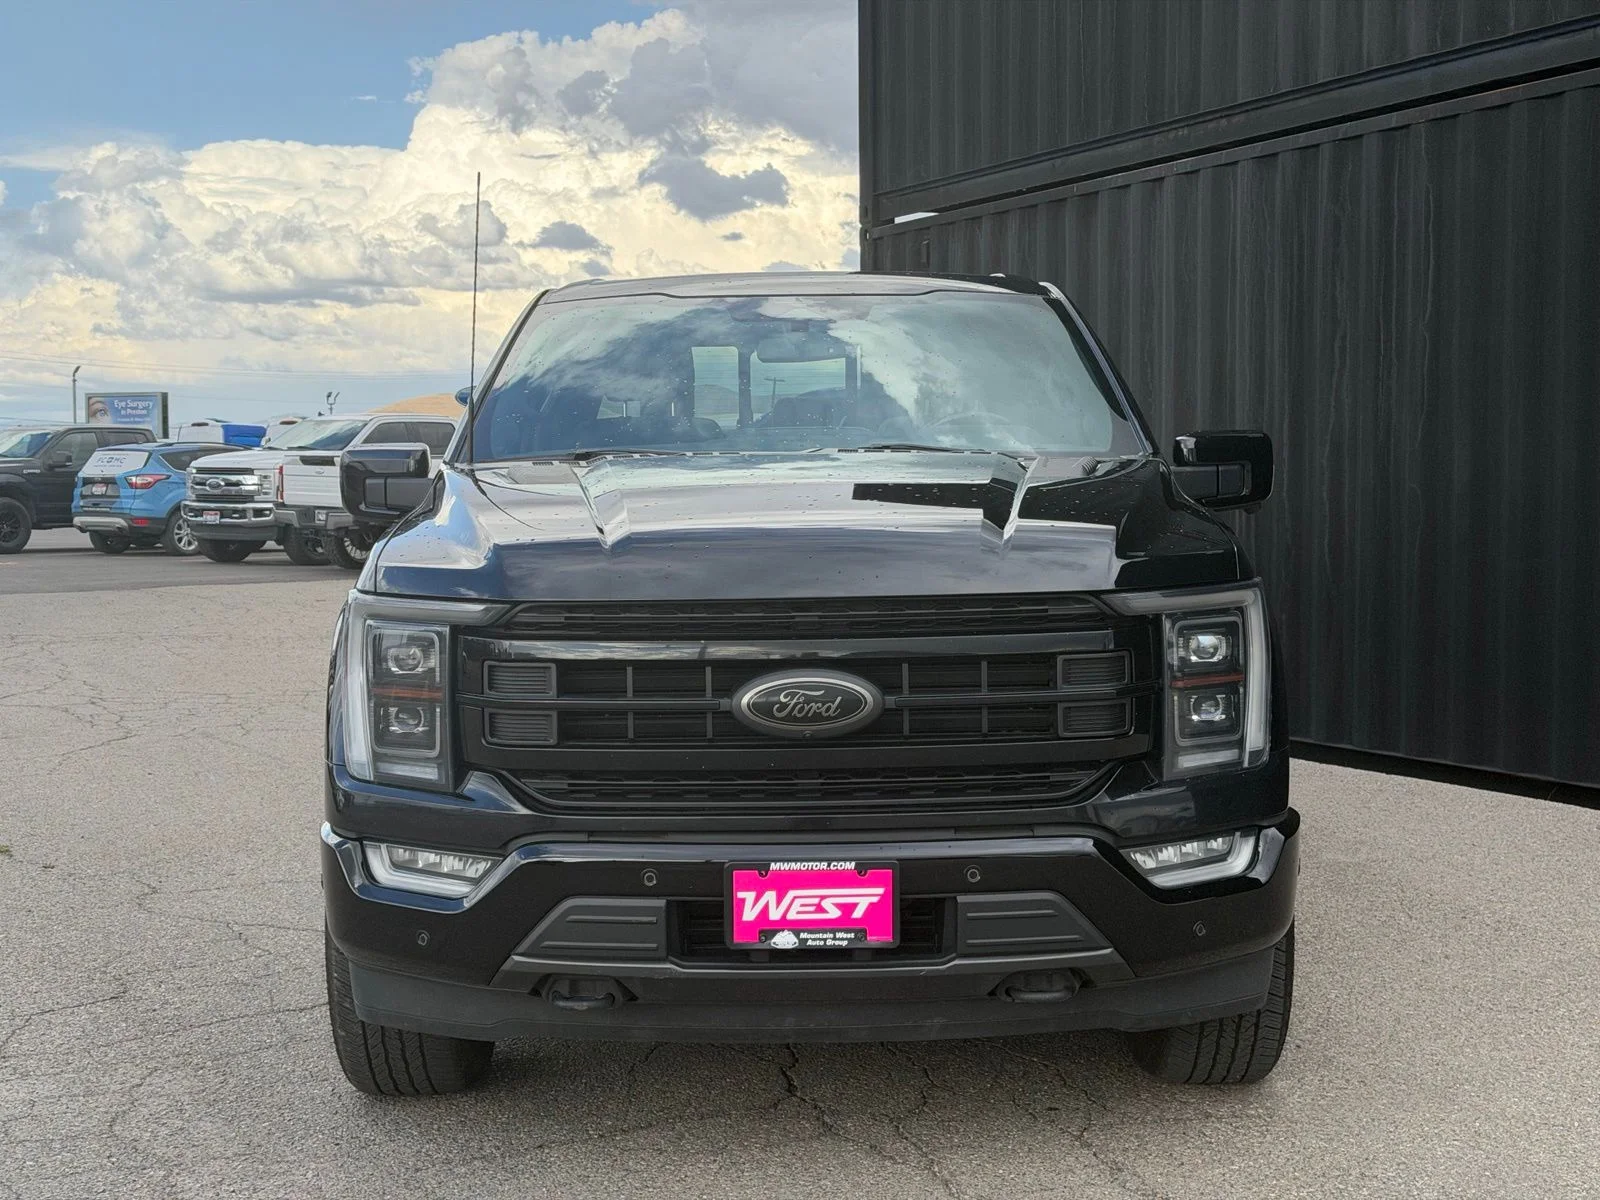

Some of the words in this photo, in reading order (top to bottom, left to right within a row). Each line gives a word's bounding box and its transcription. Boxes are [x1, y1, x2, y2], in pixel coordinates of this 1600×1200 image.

[114, 400, 126, 409] Eye
[127, 400, 153, 409] Surgery
[772, 689, 842, 718] Ford
[769, 861, 856, 871] MWMOTOR.COM
[826, 939, 848, 947] Group
